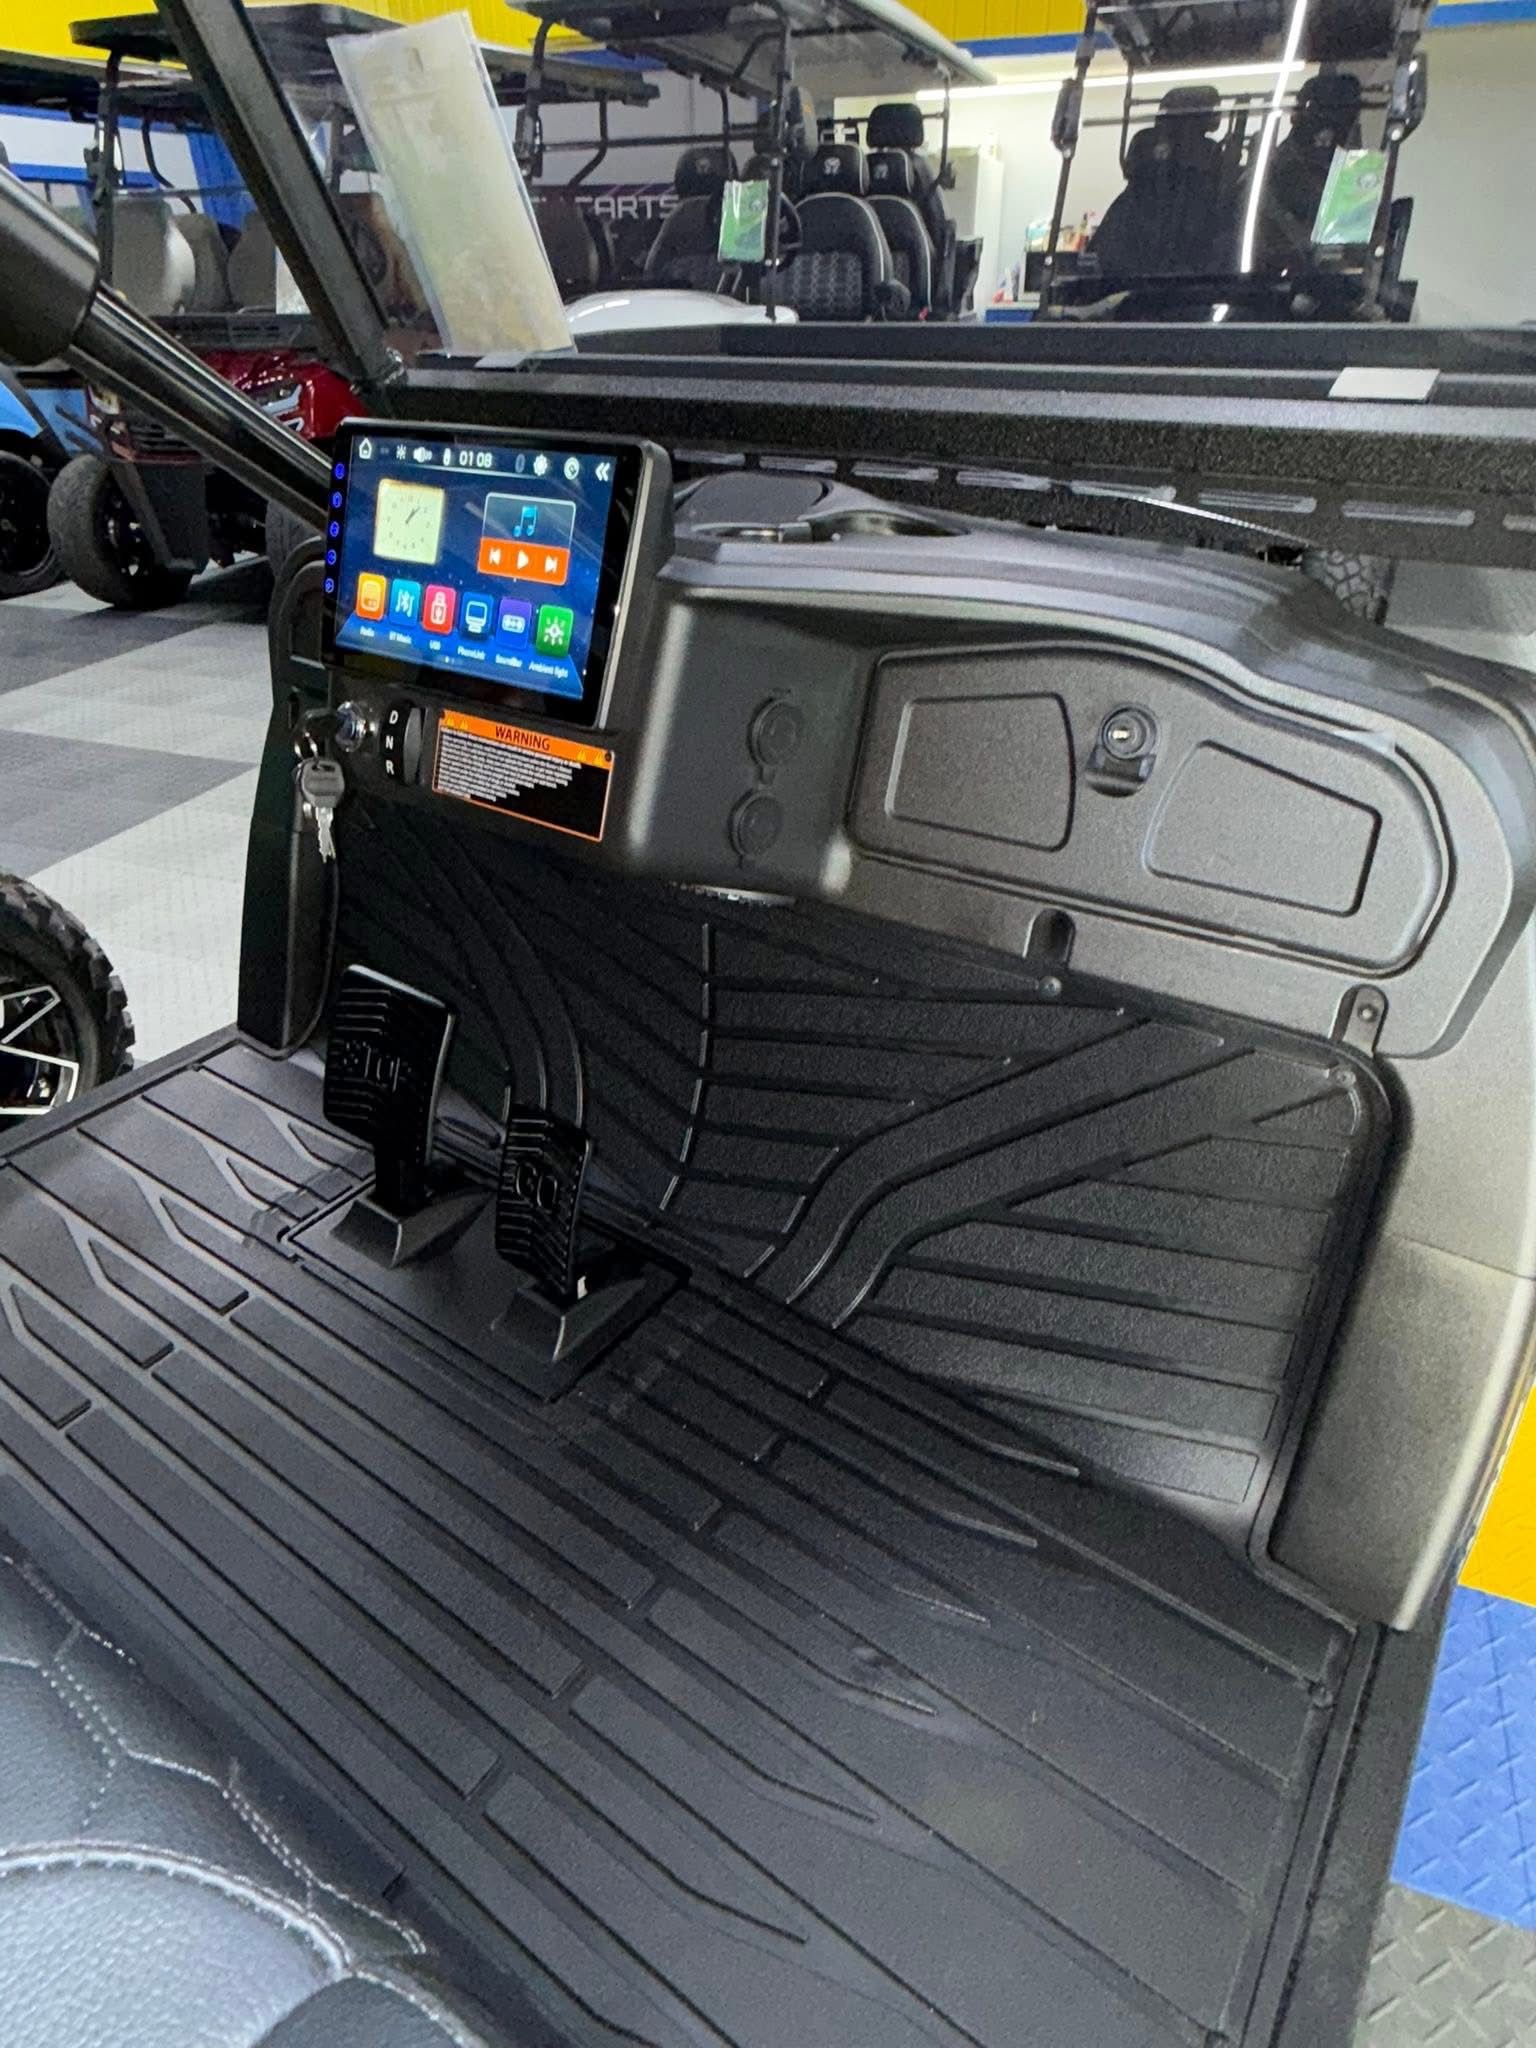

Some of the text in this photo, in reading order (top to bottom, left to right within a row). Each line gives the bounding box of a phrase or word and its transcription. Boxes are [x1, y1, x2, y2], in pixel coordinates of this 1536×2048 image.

[575, 194, 680, 220] ARTS
[389, 710, 399, 725] D
[385, 735, 395, 750] N
[495, 725, 551, 751] WARNING
[385, 759, 395, 775] R
